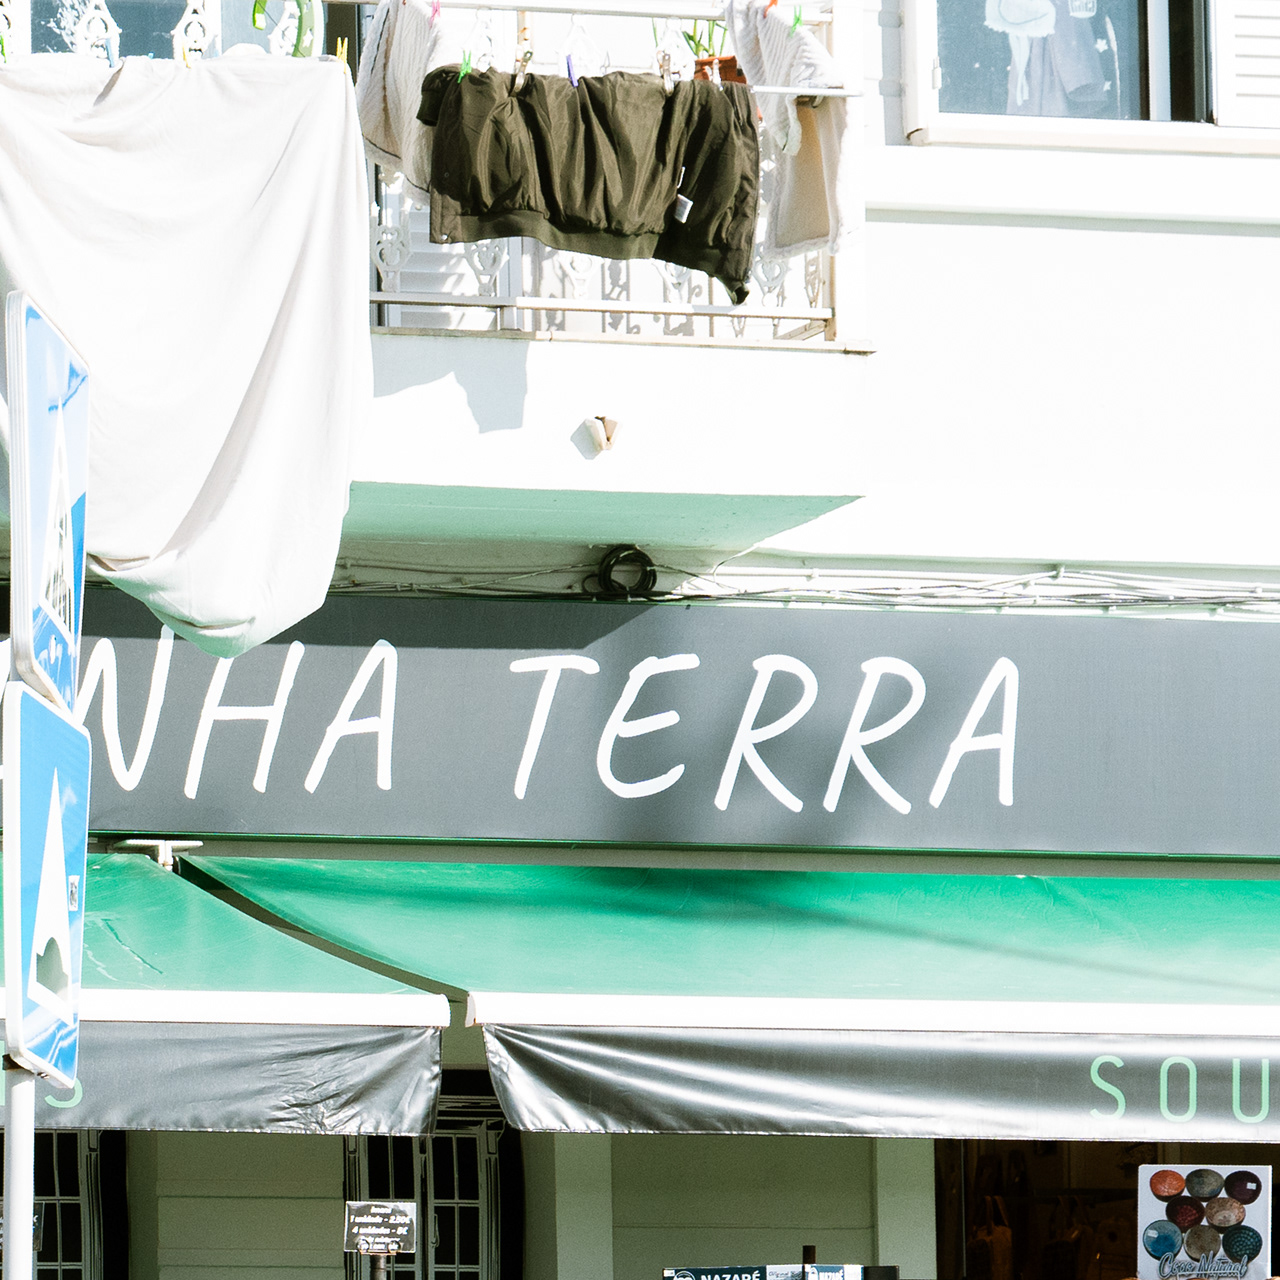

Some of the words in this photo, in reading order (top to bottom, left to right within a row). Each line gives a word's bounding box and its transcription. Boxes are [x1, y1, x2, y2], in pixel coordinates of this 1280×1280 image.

[509, 653, 1019, 815] TERRA
[1089, 1055, 1269, 1123] SOU
[351, 1226, 359, 1234] 4
